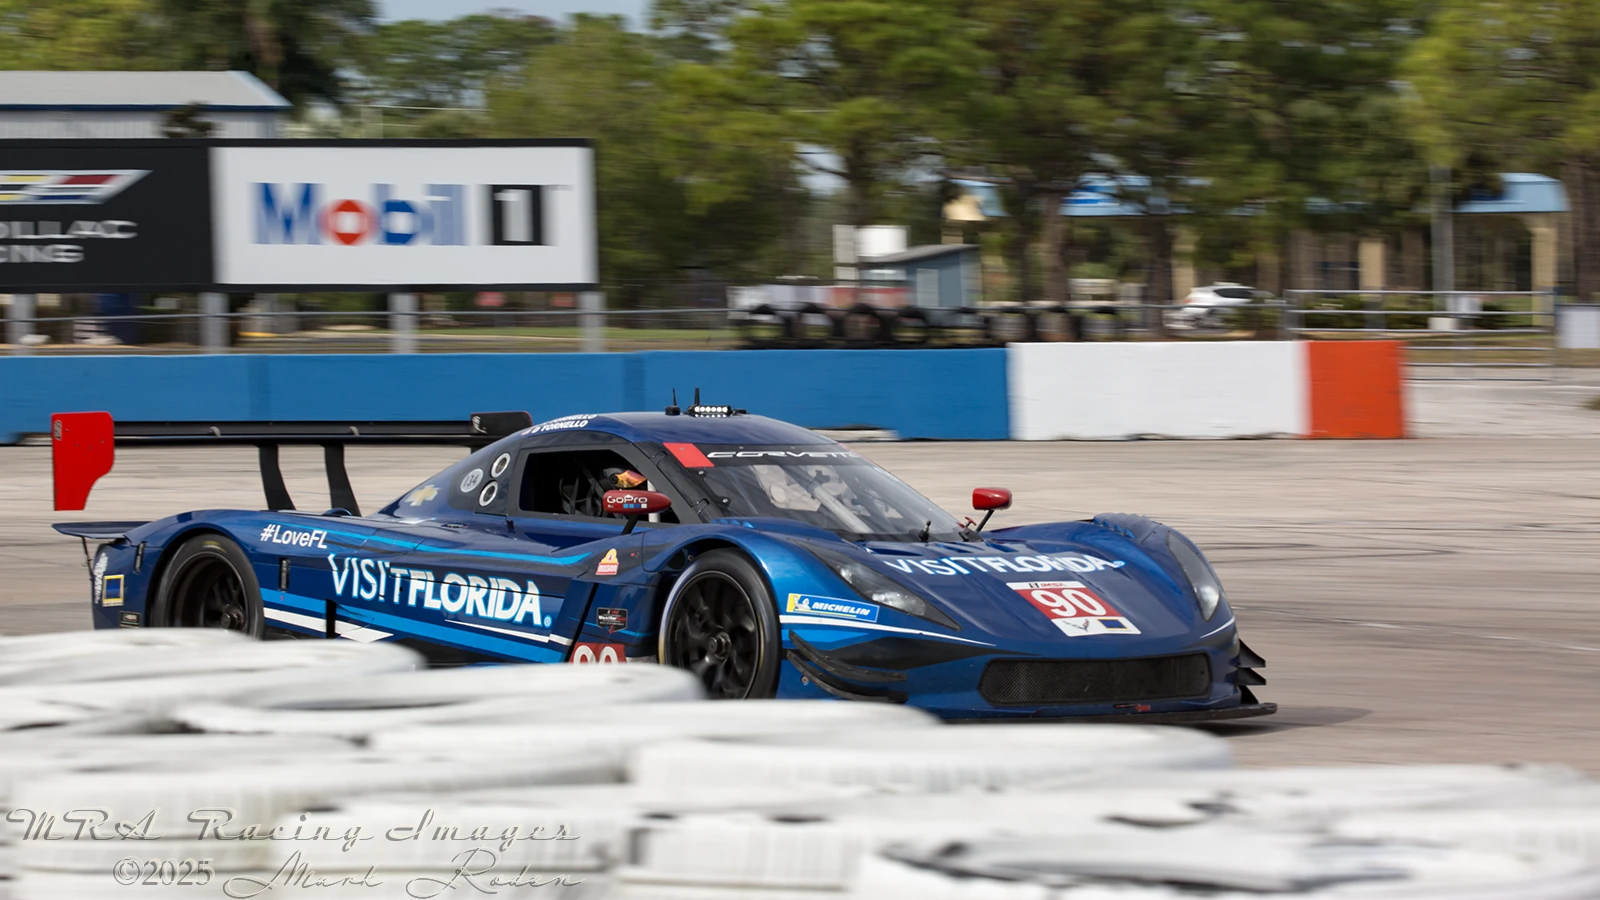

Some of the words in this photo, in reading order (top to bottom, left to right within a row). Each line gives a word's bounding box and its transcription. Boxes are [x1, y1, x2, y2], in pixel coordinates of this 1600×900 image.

[249, 182, 471, 246] Mobil
[606, 494, 648, 504] GoPro
[260, 523, 328, 549] #LoveFL
[811, 601, 871, 616] MICHELIN
[1030, 588, 1107, 617] 90
